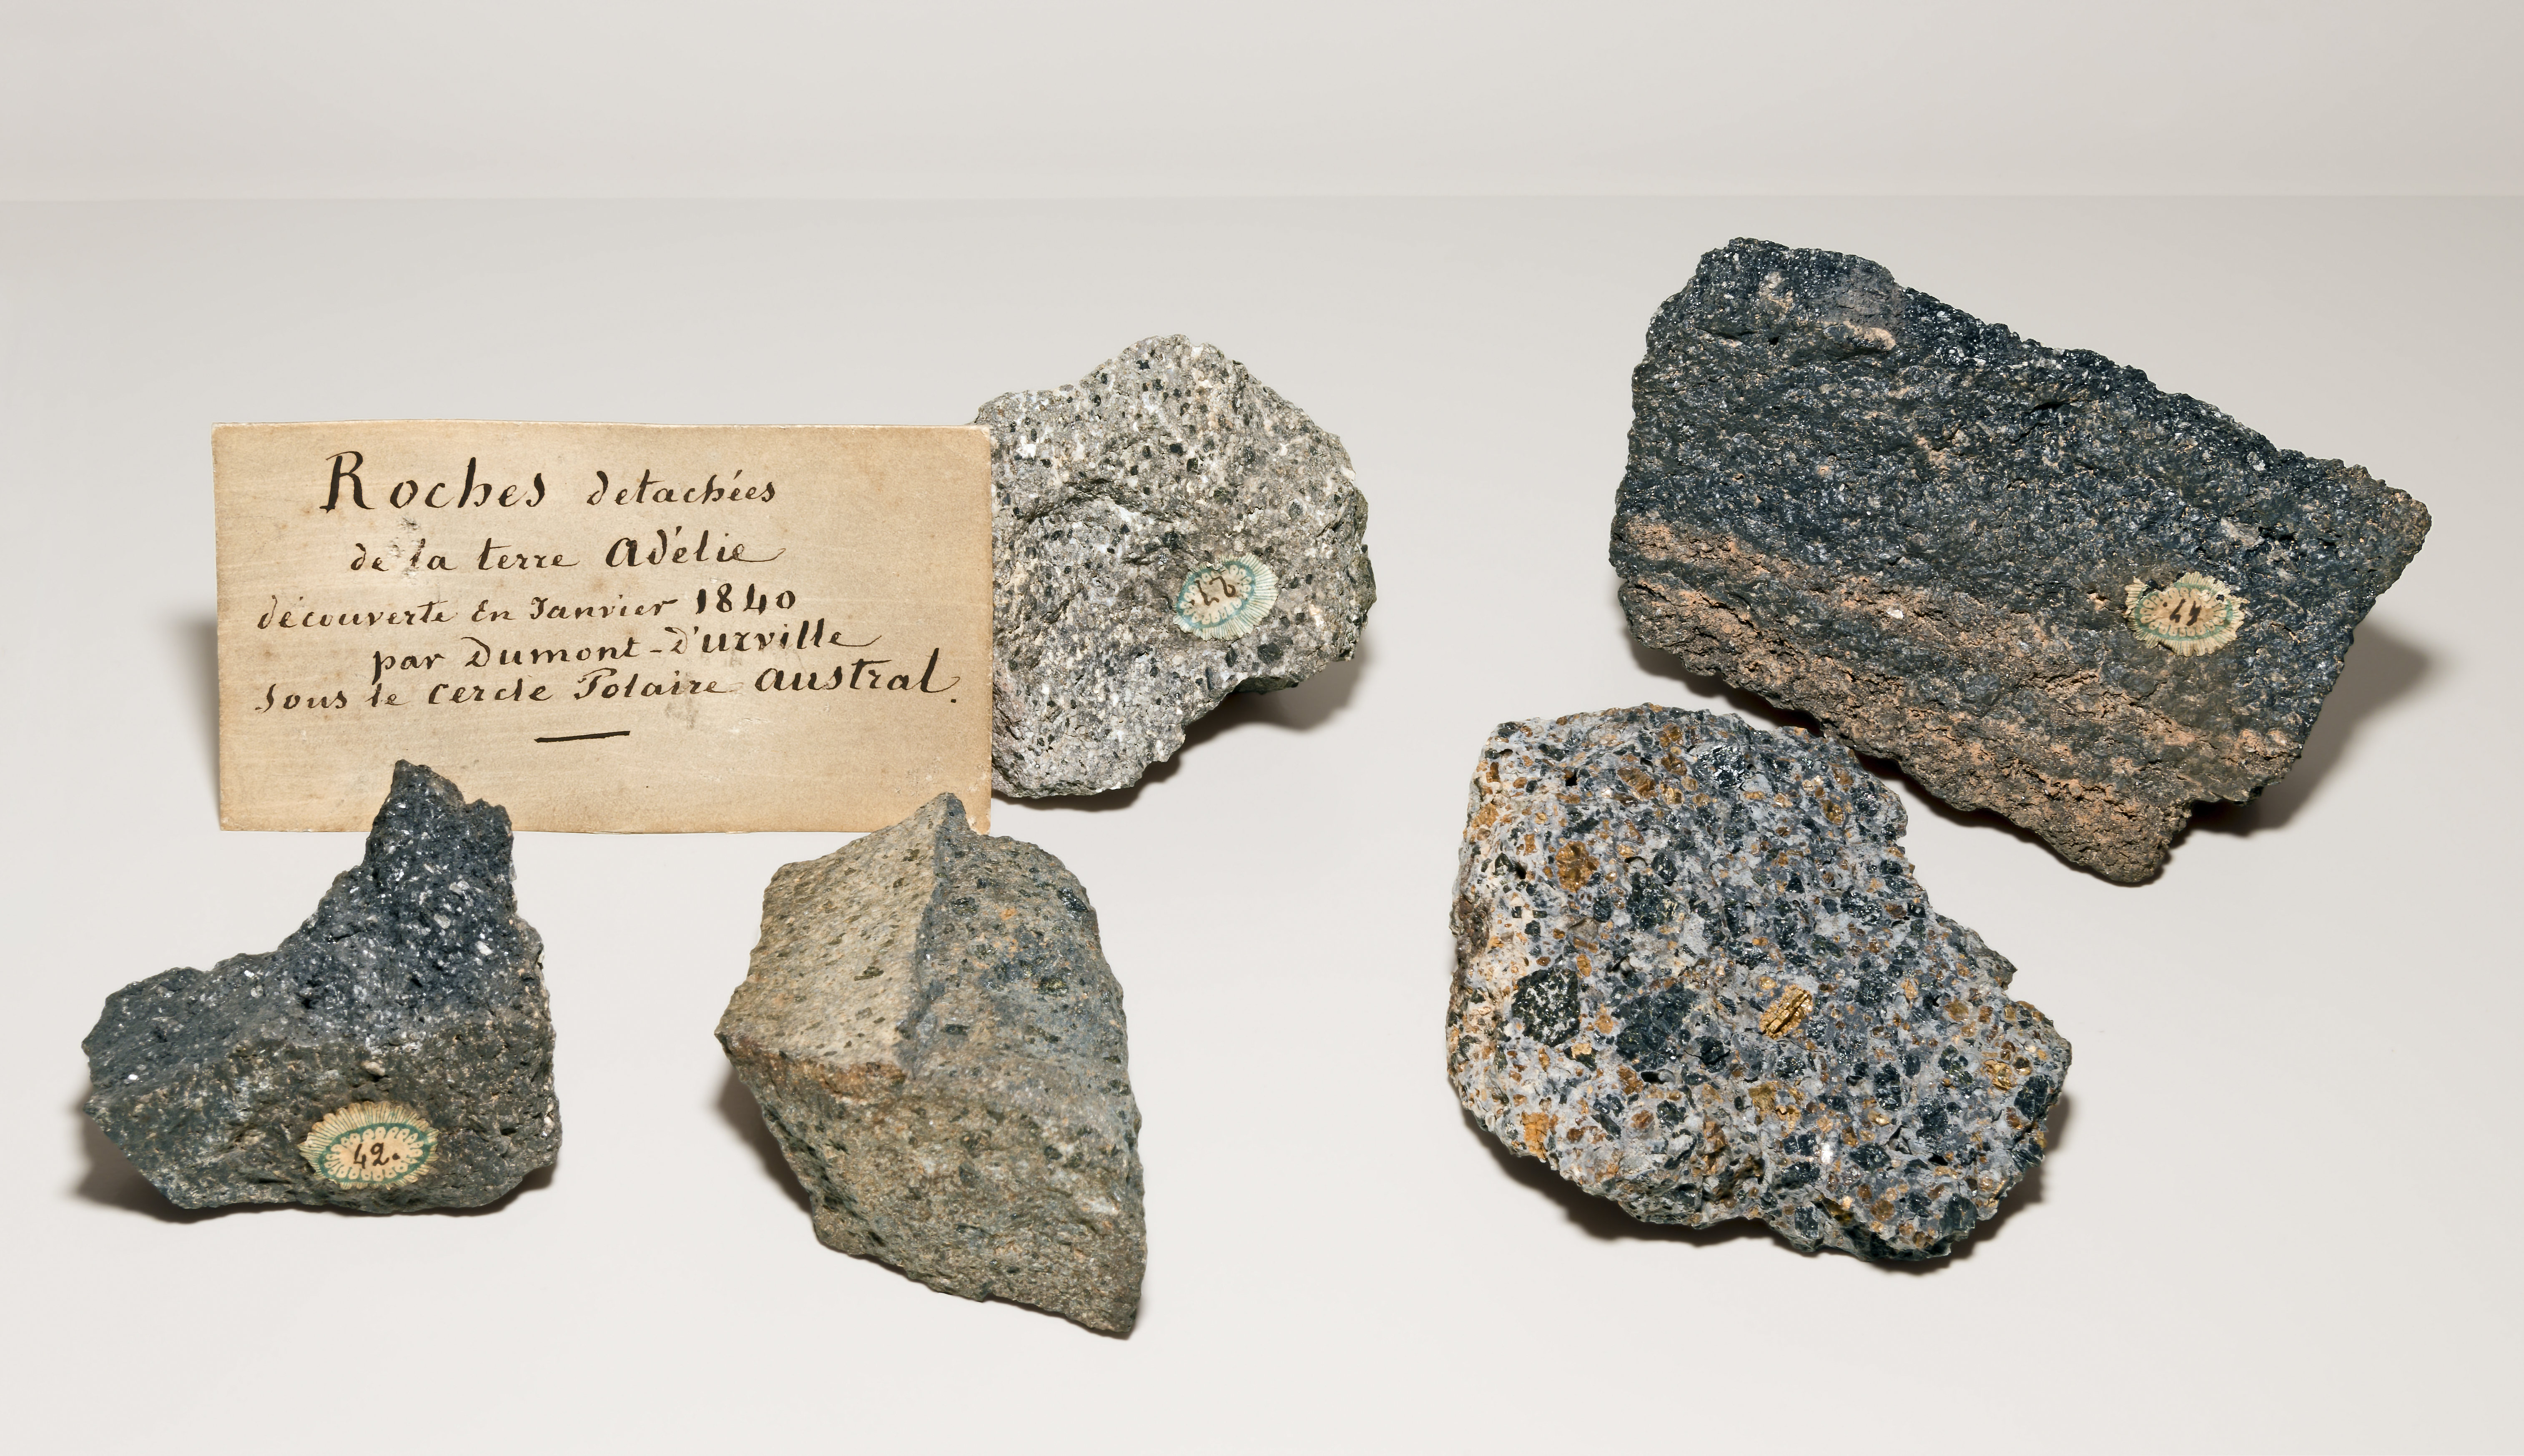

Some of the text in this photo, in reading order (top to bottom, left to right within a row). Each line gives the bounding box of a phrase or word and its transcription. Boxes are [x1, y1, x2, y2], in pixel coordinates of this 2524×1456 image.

[319, 450, 546, 514] Roches
[350, 543, 389, 572] de
[409, 538, 457, 571] la
[476, 537, 580, 570] terre
[257, 594, 458, 630] découverte
[695, 582, 796, 616] 1840
[364, 682, 411, 709] le
[573, 667, 745, 701] Polaire
[371, 650, 446, 686] par
